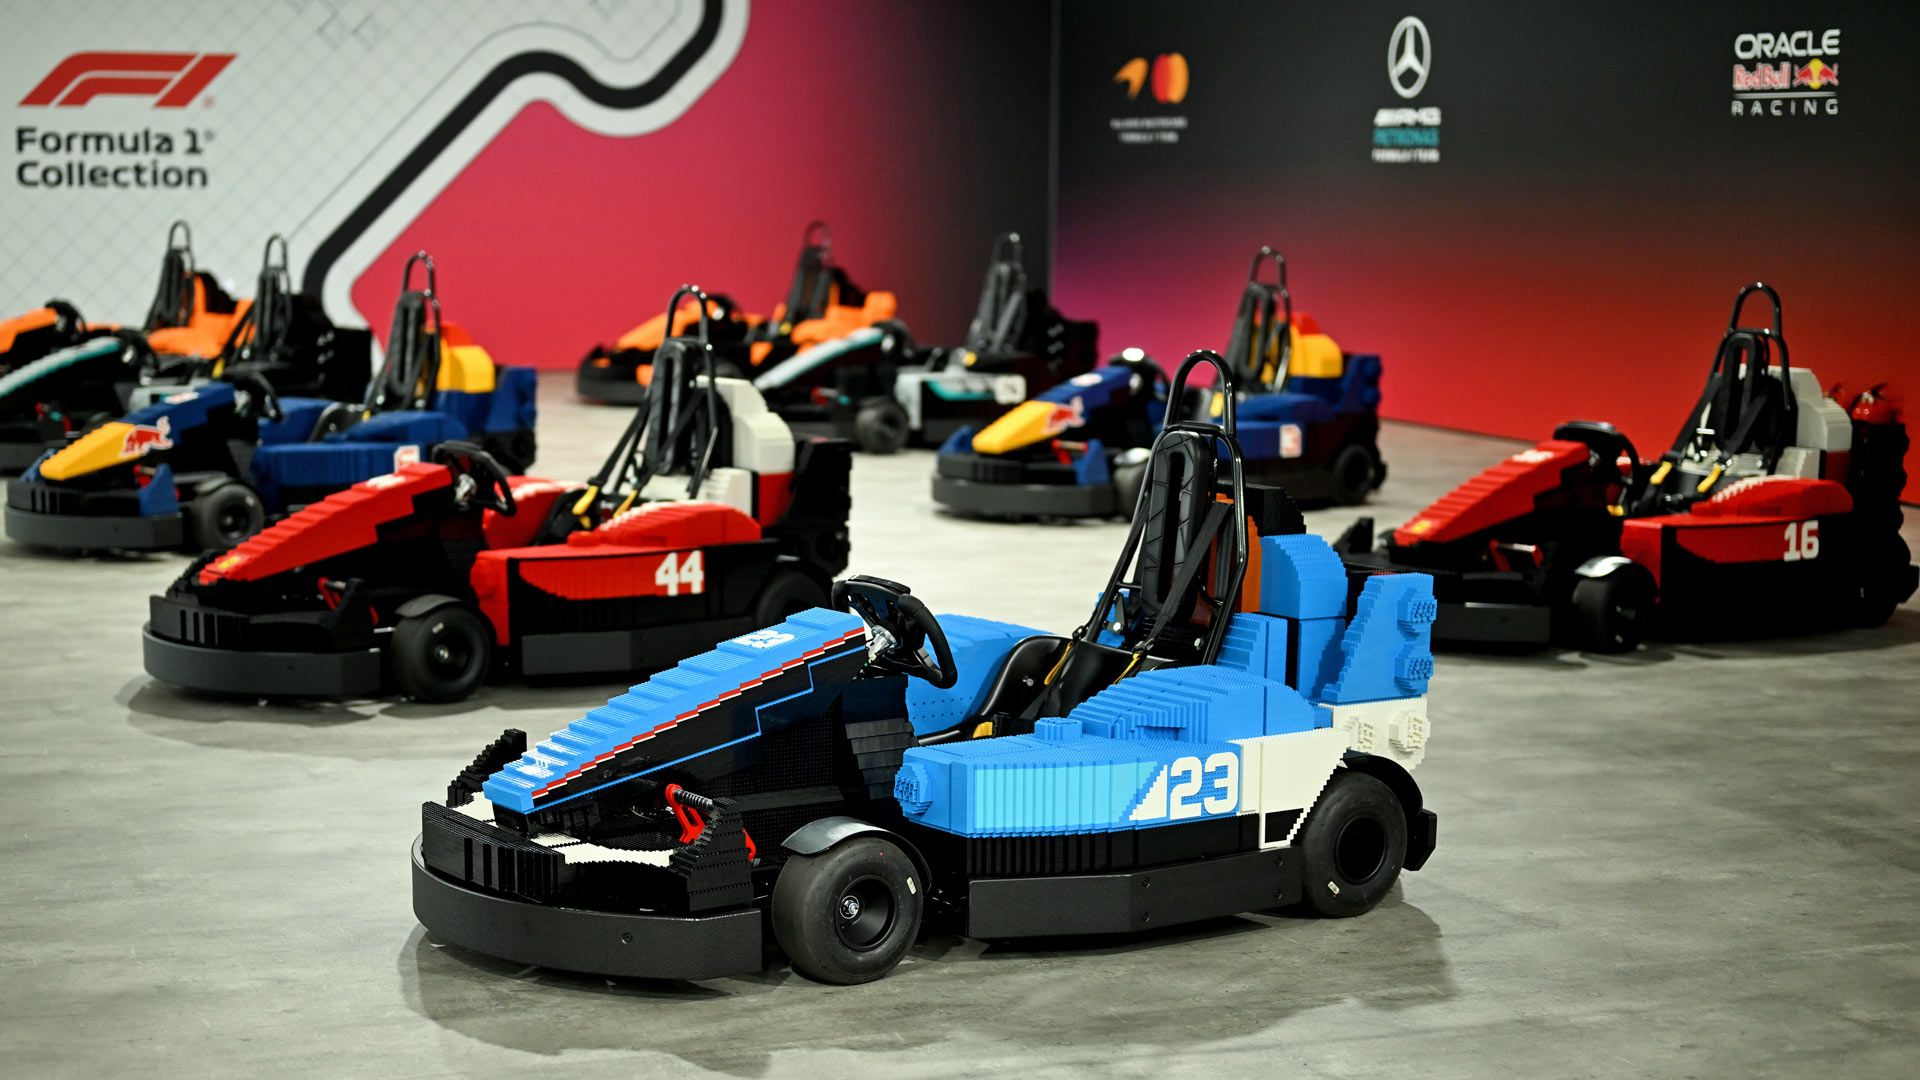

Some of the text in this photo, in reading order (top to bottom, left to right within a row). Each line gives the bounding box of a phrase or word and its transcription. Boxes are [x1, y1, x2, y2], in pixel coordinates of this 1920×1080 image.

[1734, 28, 1841, 60] ORACLE
[1731, 98, 1839, 117] RACING
[16, 125, 174, 155] Formula
[16, 160, 209, 189] Collection
[1783, 519, 1820, 563] 16
[655, 549, 705, 597] 44
[1169, 751, 1240, 821] 23
